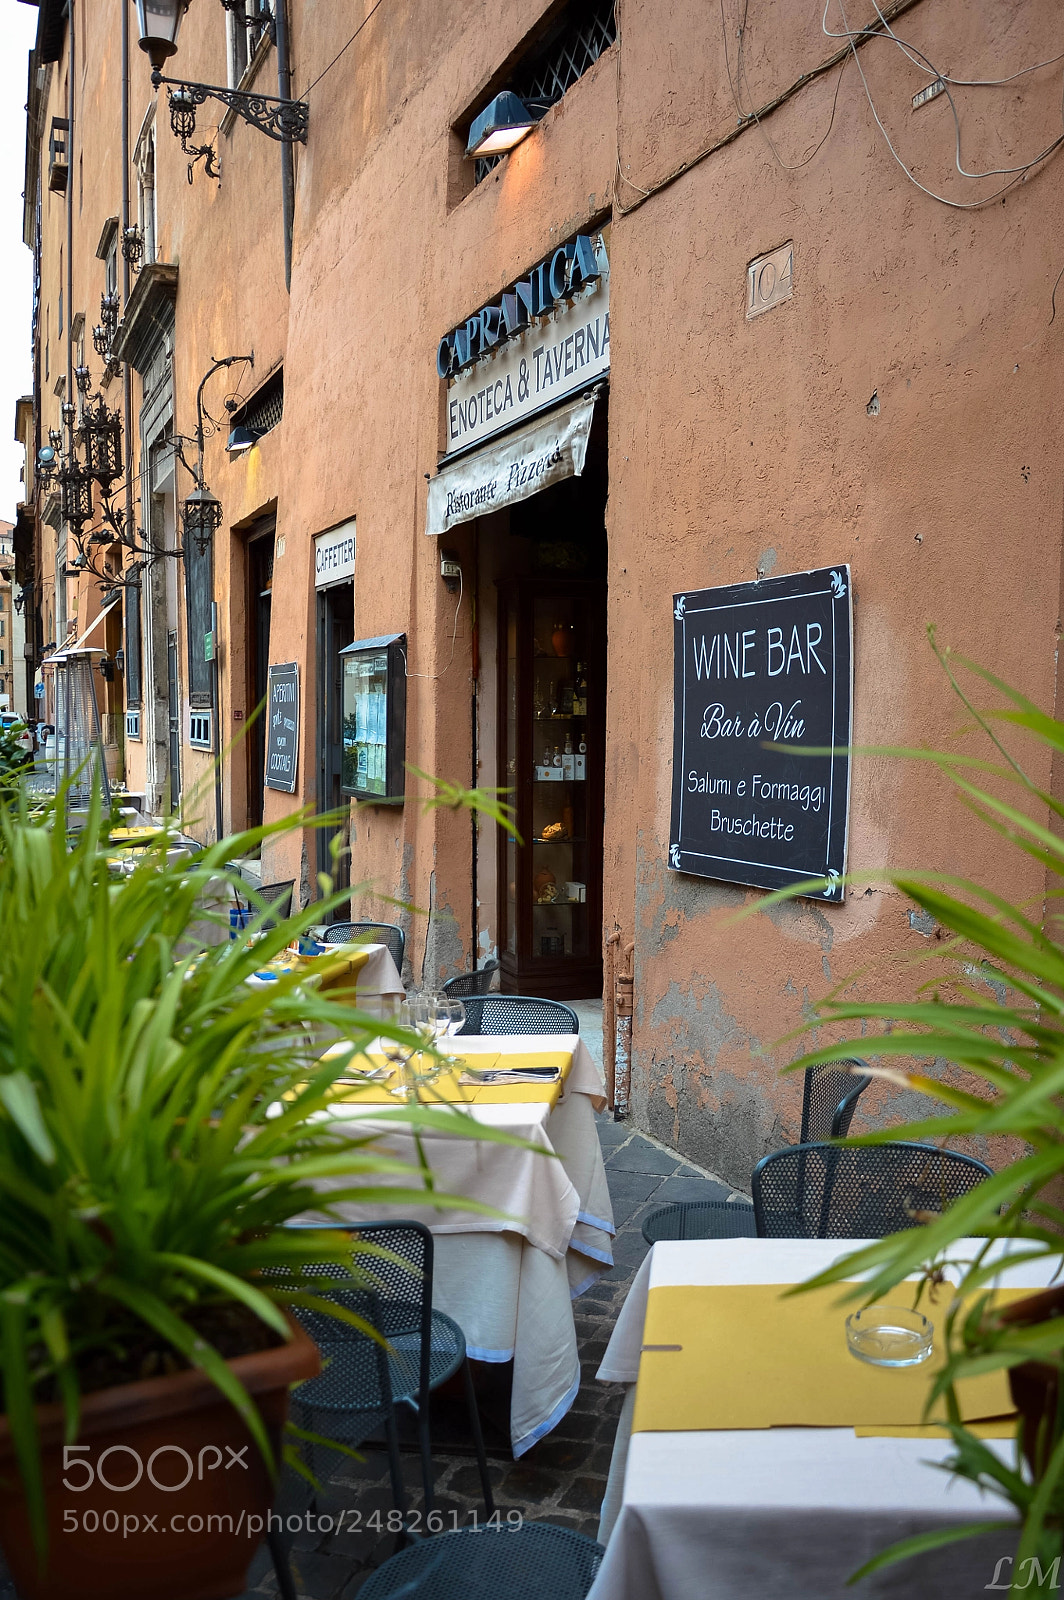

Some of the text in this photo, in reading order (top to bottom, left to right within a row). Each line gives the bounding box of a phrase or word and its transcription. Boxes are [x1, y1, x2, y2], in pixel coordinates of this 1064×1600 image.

[750, 250, 792, 308] 104
[437, 234, 600, 379] CAPRANICA
[450, 311, 610, 440] ENOTECA & TAVERNA
[445, 480, 497, 518] Ristorante
[693, 622, 827, 681] WINE BAR
[700, 699, 806, 741] Bar à Vin
[687, 770, 826, 812] Salumi e Formaggi
[710, 809, 795, 842] Bruschette
